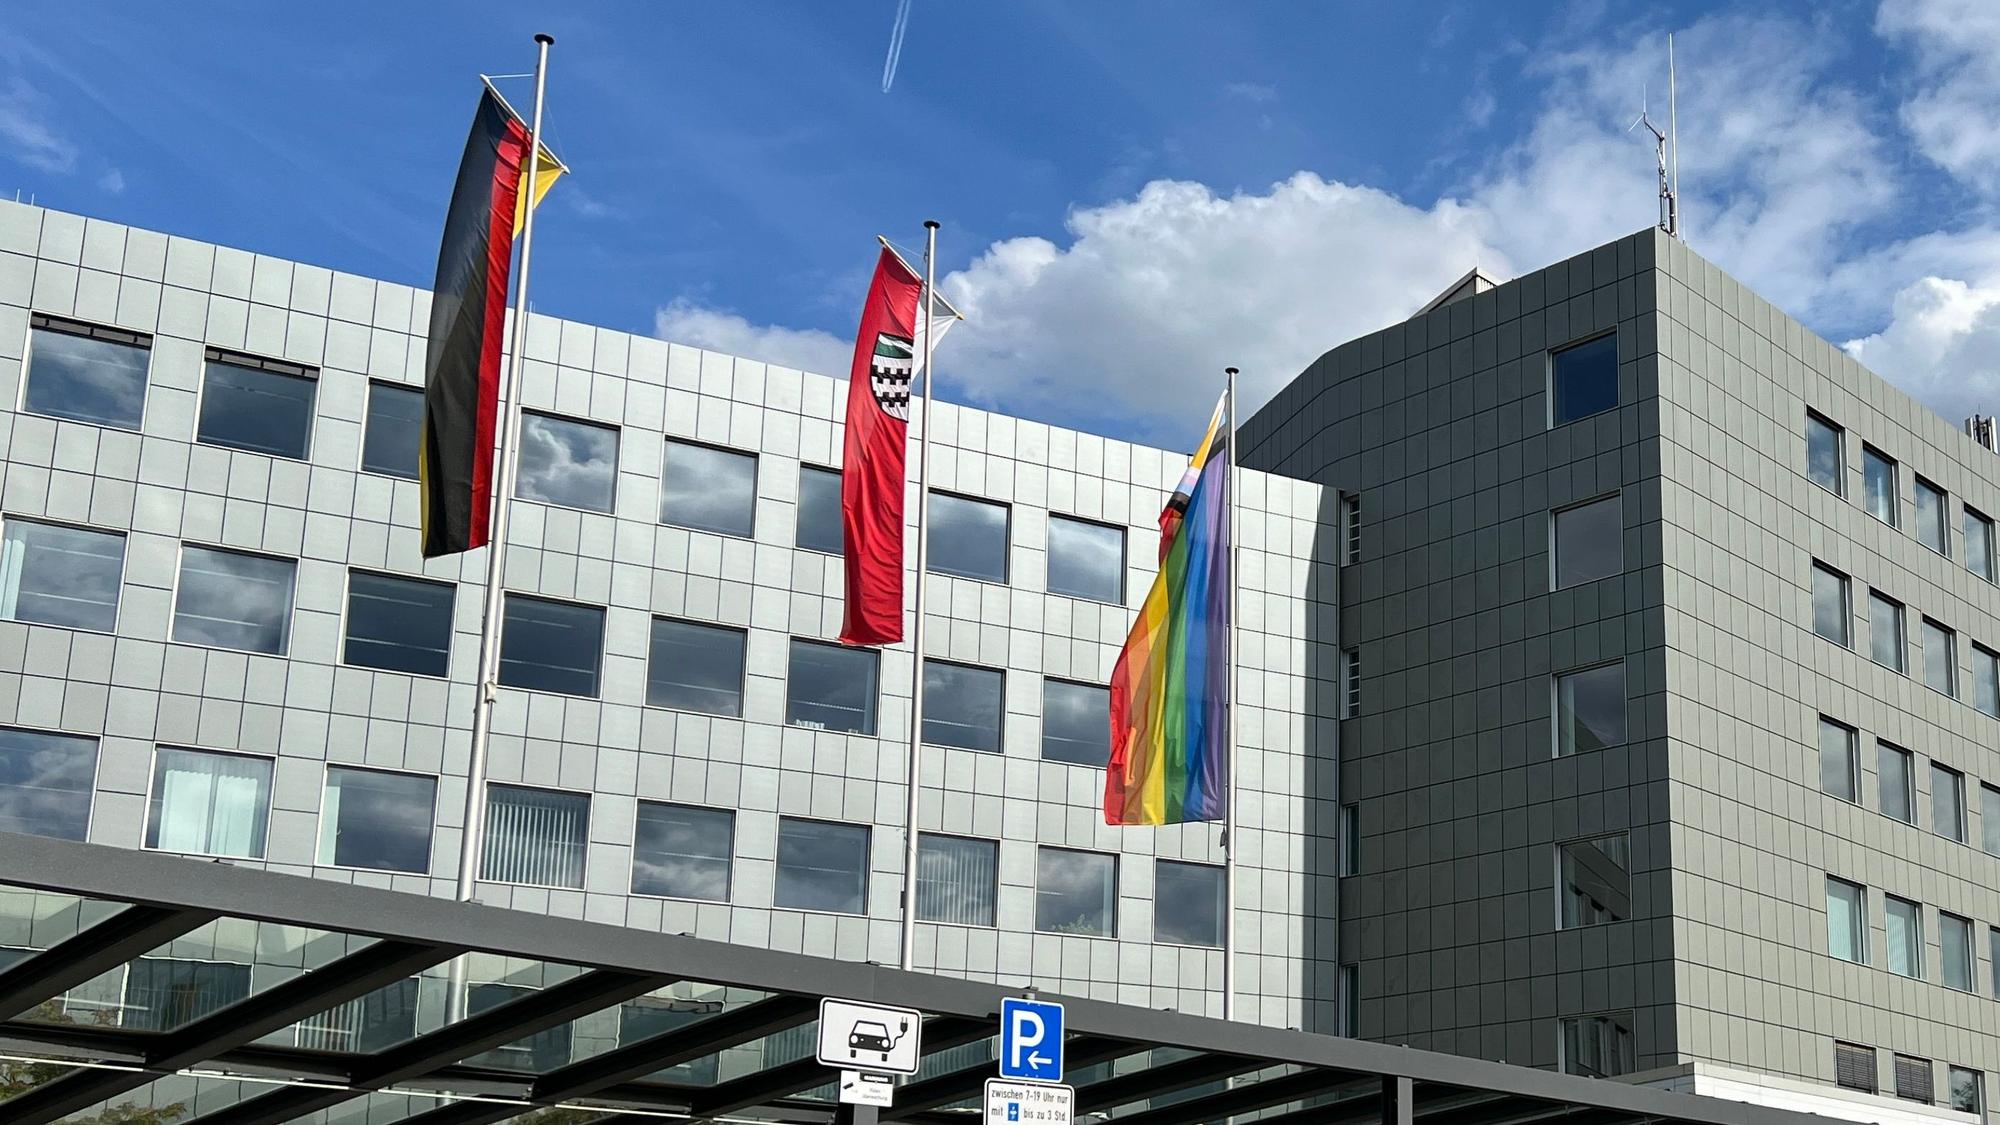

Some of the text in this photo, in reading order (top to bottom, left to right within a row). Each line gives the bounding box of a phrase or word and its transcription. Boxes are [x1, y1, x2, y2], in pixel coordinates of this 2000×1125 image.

[1011, 1009, 1045, 1068] P
[991, 1089, 1068, 1104] zwischen 7-19 Uhr nur
[991, 1107, 1003, 1116] mit
[1023, 1109, 1033, 1119] bis
[1036, 1111, 1044, 1120] zu
[1047, 1110, 1052, 1121] 3
